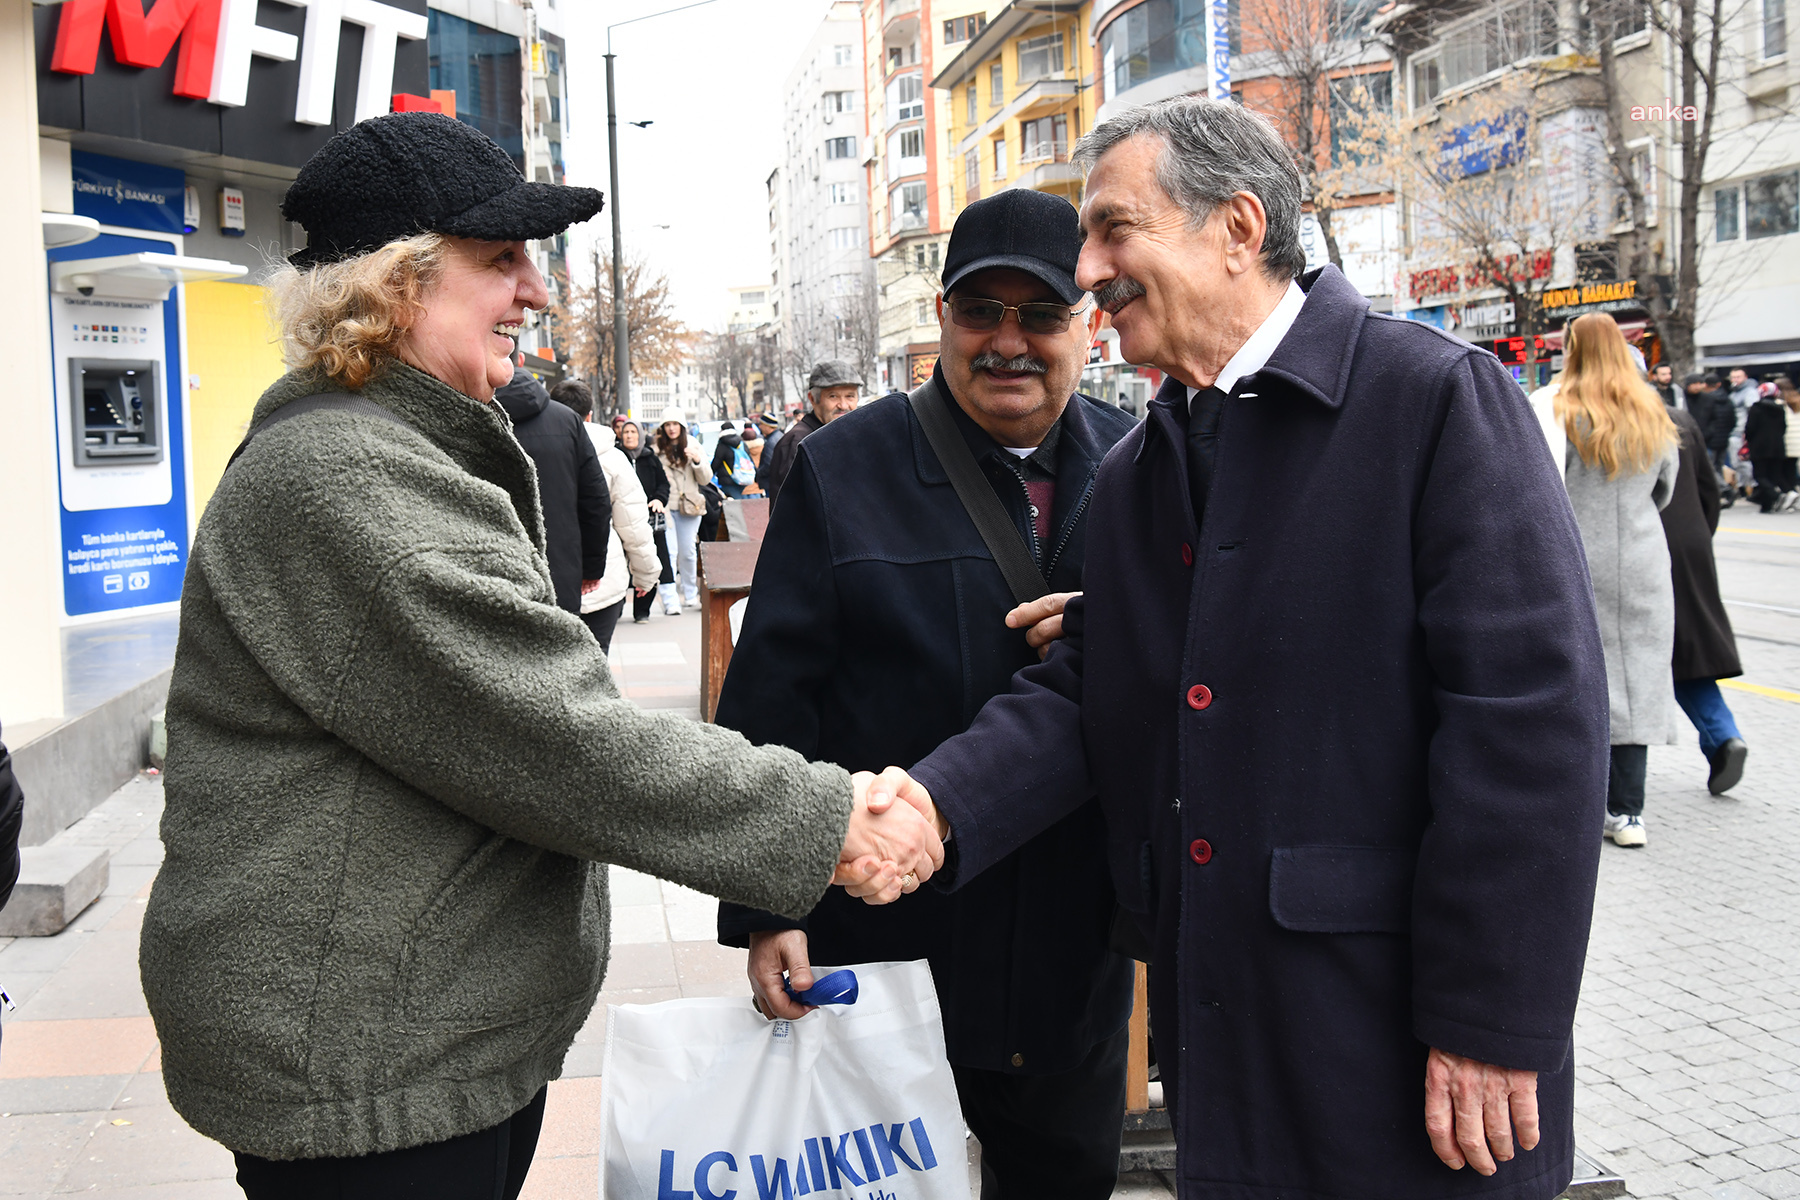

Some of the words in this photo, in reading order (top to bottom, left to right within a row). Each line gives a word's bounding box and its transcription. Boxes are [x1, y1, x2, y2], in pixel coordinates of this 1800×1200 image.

[72, 180, 113, 197] TÜRKİYE
[125, 190, 165, 204] BANKASI
[1543, 288, 1580, 309] DÜNYA
[1581, 280, 1637, 304] BAHARAT
[81, 534, 100, 545] Tüm
[100, 532, 125, 544] banka
[68, 549, 100, 561] kolayca
[100, 547, 119, 560] para
[145, 543, 155, 552] ve
[657, 1149, 738, 1200] LC
